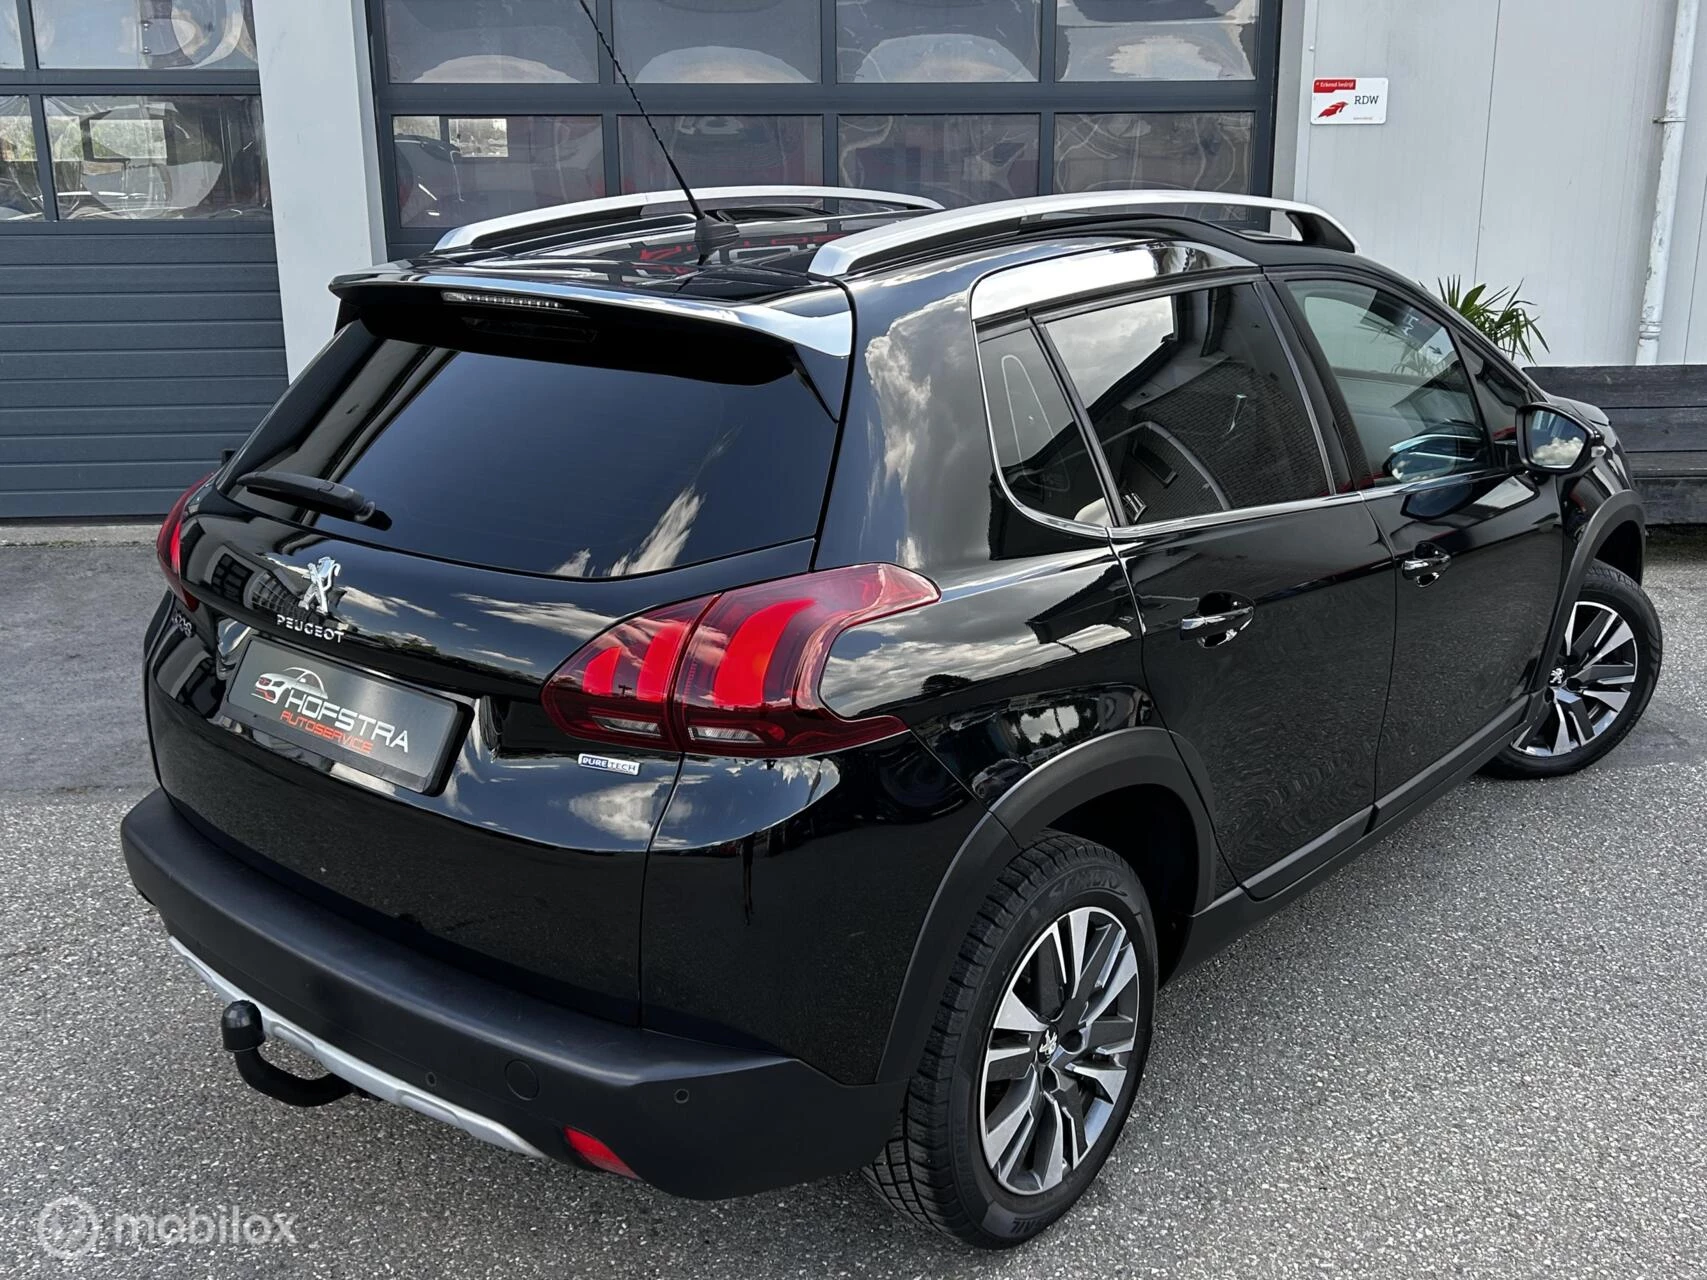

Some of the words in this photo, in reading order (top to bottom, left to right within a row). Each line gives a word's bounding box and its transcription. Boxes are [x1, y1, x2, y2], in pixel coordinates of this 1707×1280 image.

[1354, 95, 1379, 105] RDW
[276, 613, 345, 644] PEUGEOT
[280, 710, 374, 754] AUTOSERVICE
[284, 688, 410, 753] HOFSTRA
